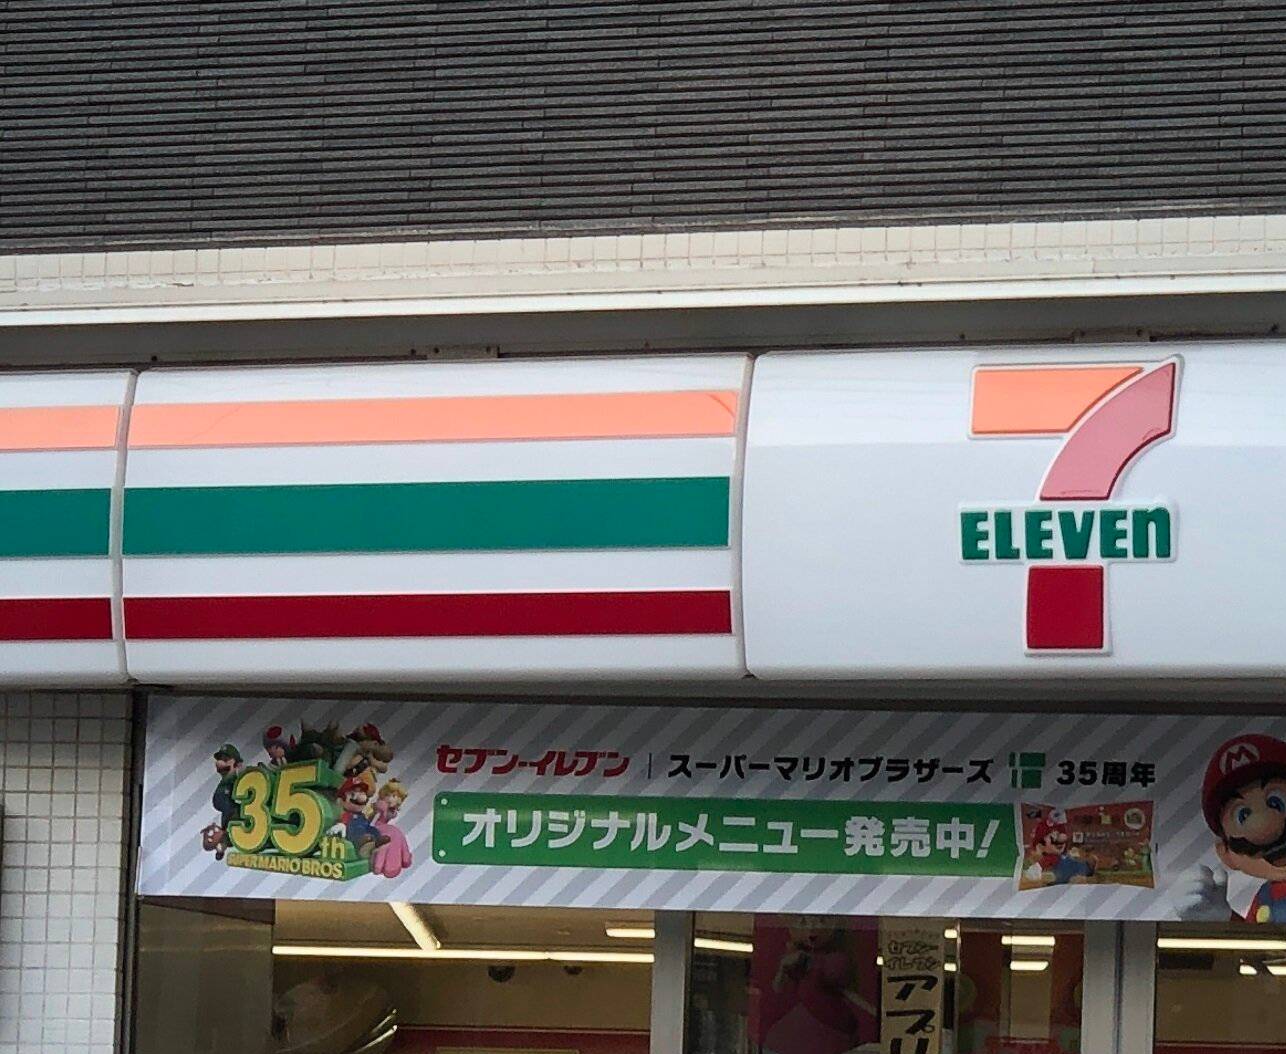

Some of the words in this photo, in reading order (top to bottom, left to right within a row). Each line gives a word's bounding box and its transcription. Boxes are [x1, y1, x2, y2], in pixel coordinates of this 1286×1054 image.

[667, 752, 995, 786] スーパーマリオブラザーズ
[1056, 760, 1157, 789] 35周年
[229, 765, 323, 854] 35
[320, 836, 346, 860] th
[462, 807, 1001, 861] オリジナルメニュー発売中!
[258, 855, 301, 872] MARIO
